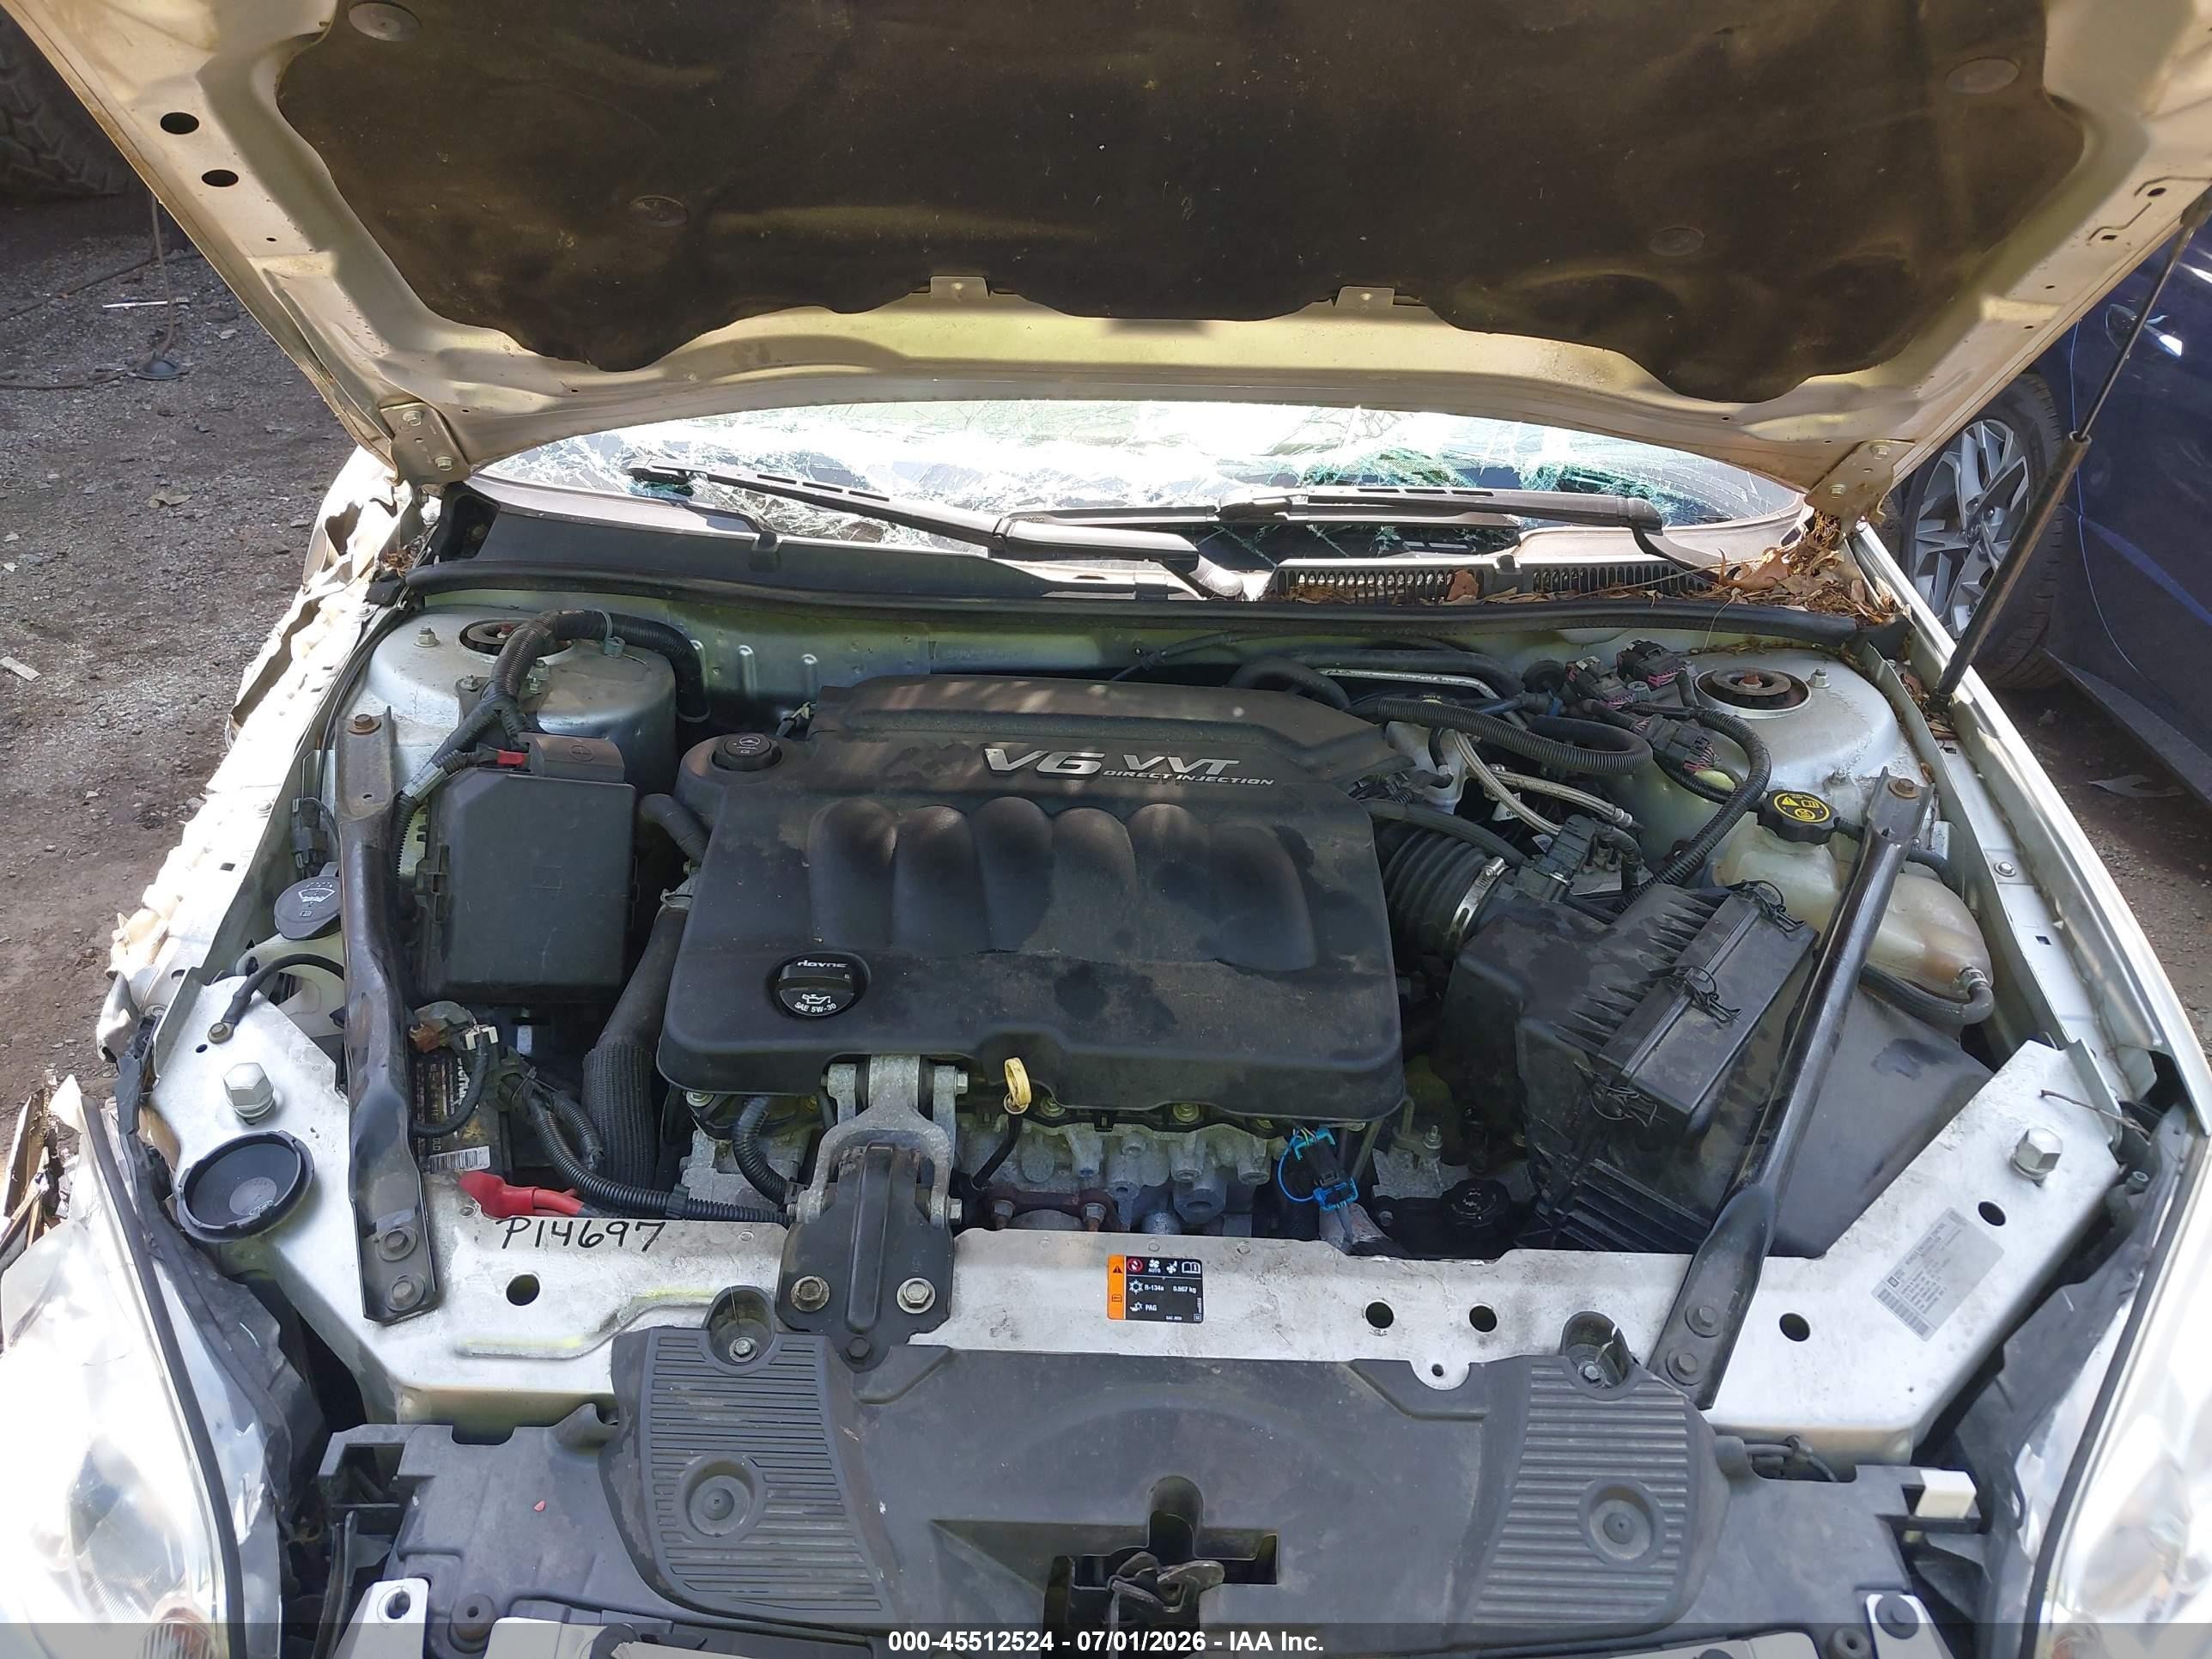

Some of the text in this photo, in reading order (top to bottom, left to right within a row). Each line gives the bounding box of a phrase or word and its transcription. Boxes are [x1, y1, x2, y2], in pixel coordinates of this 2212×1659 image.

[983, 748, 1240, 775] V6 VVT
[1103, 769, 1274, 786] DIRECT INJECTION
[794, 1001, 837, 1013] SAE 5W-30
[495, 1216, 666, 1253] P14697
[1188, 1285, 1197, 1294] kg
